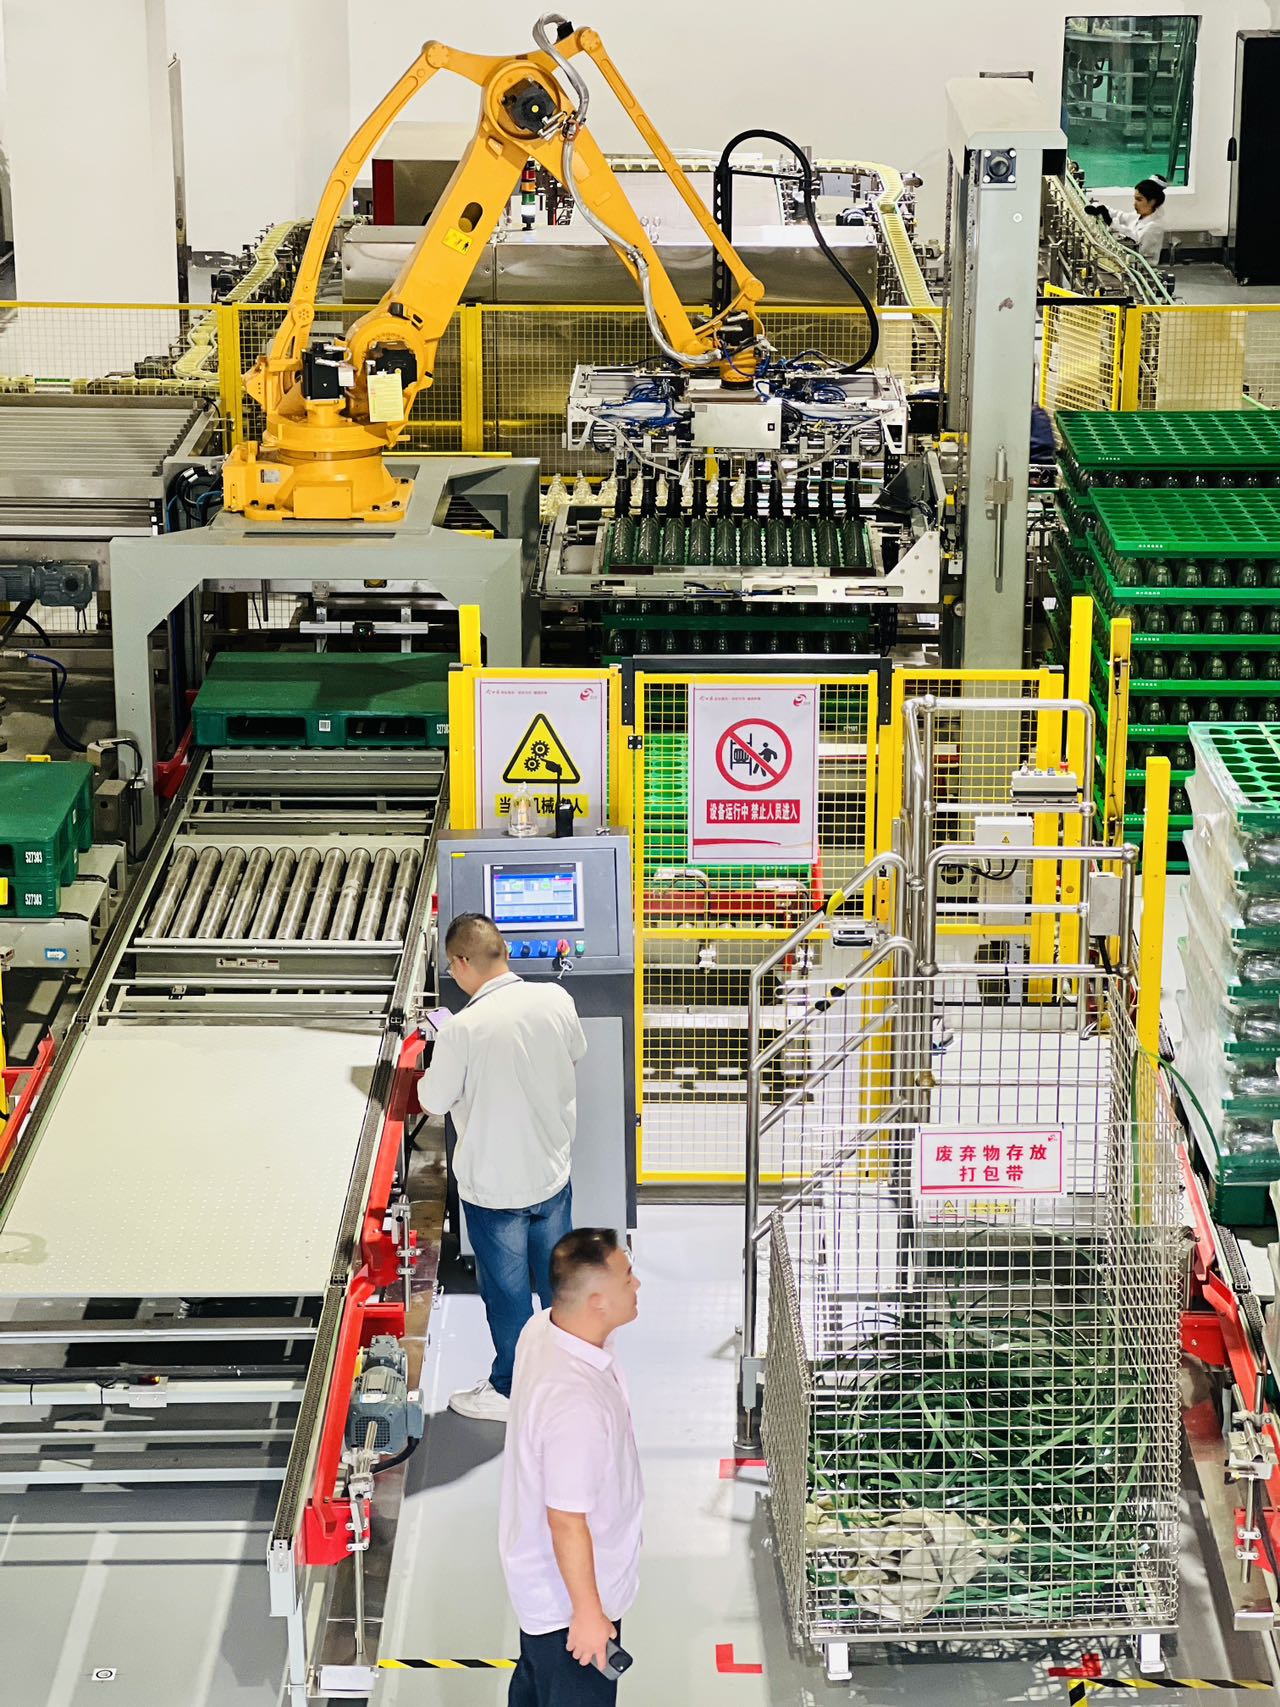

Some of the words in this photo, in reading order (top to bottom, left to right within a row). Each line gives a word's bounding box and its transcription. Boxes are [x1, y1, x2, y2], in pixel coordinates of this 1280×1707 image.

[709, 802, 749, 821] 设备运行中
[751, 802, 798, 821] 禁止人员进入
[935, 1144, 1048, 1162] 废弃物存放
[959, 1164, 1024, 1182] 打包带
